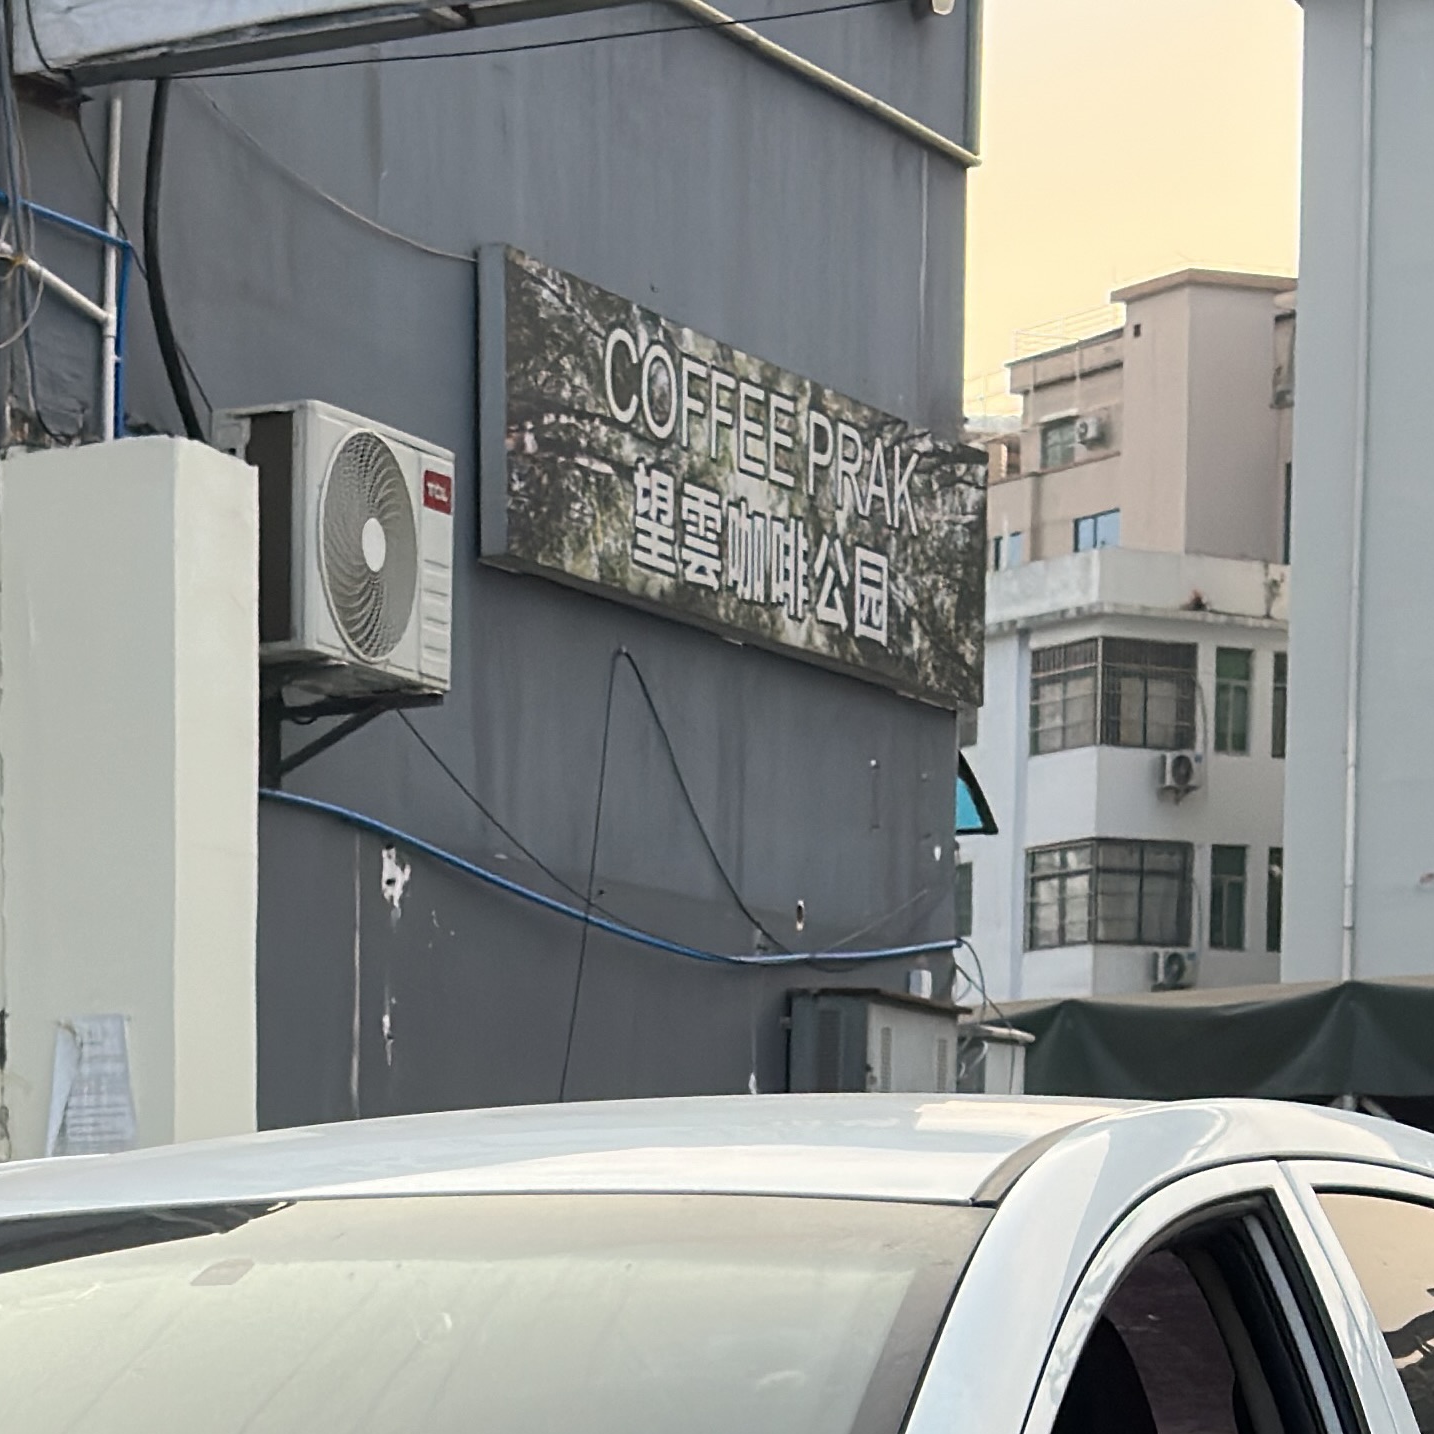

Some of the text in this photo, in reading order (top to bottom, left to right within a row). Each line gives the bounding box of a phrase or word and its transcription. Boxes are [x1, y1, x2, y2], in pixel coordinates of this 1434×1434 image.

[605, 328, 919, 536] COFFEE PRAK
[633, 457, 888, 647] 望雲咖啡公园
